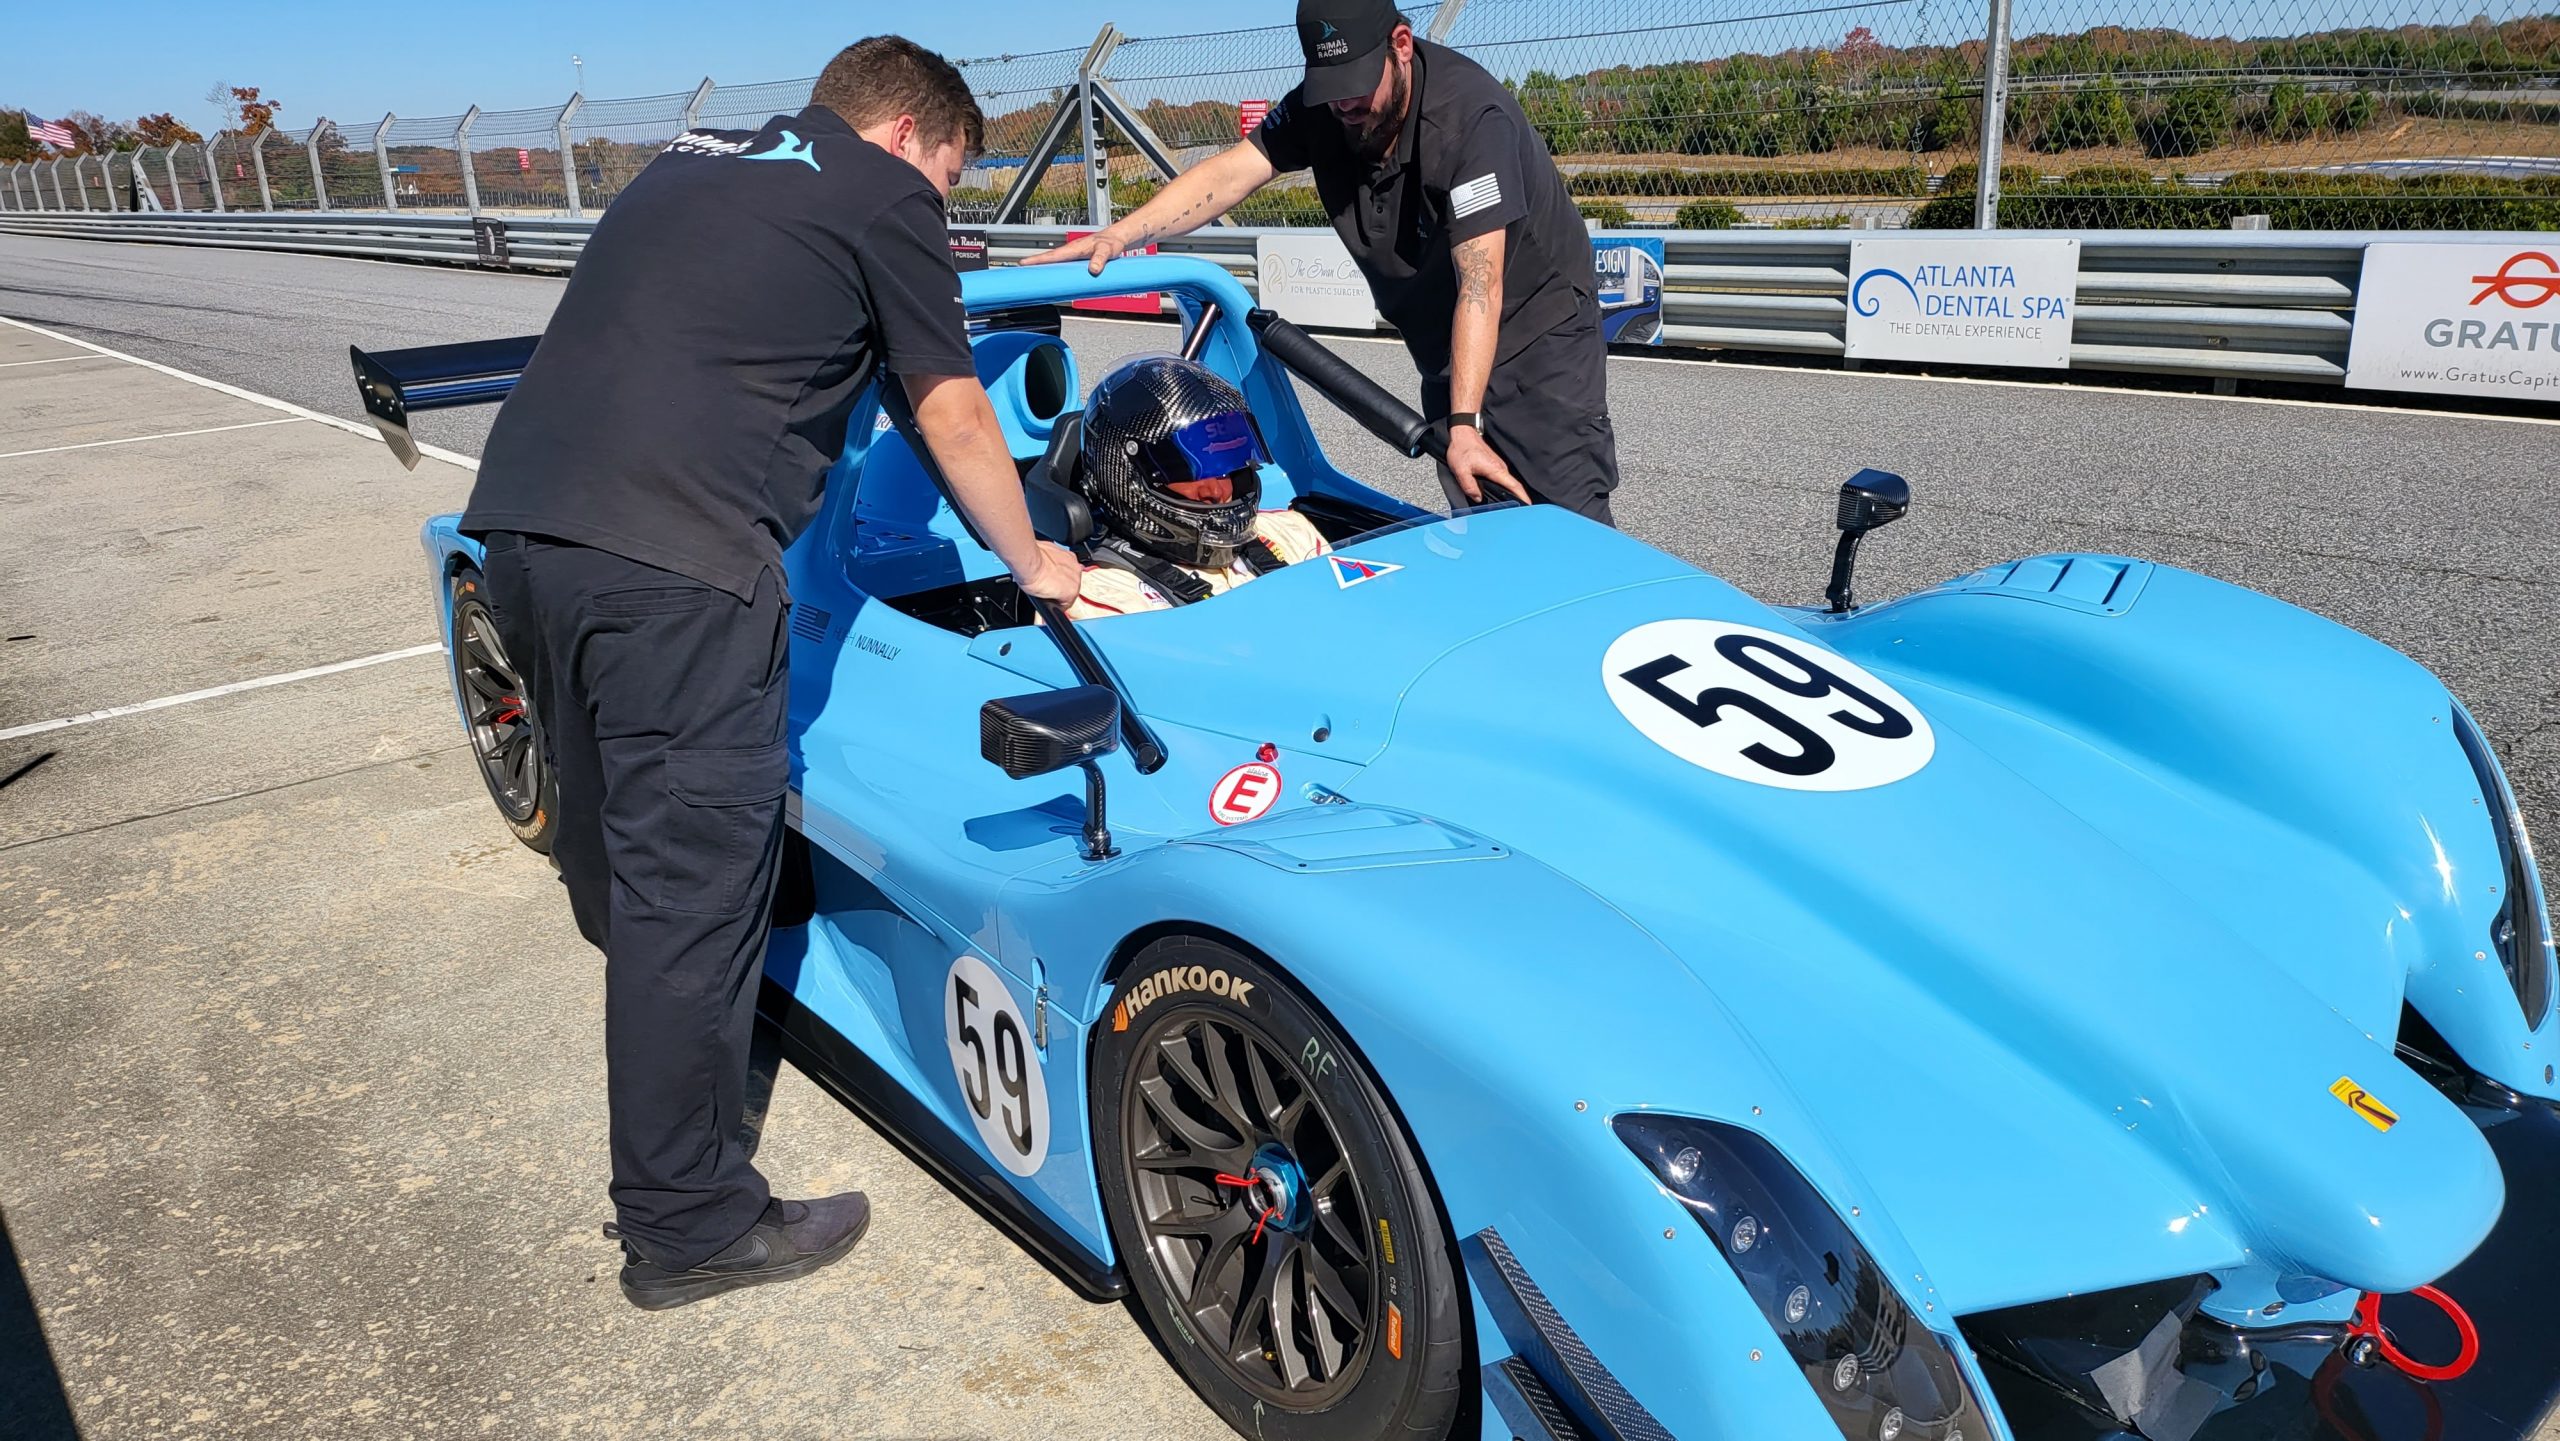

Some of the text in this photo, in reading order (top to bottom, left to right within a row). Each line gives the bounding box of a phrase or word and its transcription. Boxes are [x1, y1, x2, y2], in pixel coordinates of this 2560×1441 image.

[1316, 38, 1347, 51] PRIMAL
[1318, 45, 1349, 59] RACING
[1288, 257, 1306, 279] The
[1307, 258, 1335, 279] Swan
[1595, 249, 1626, 273] ESIGN
[1914, 265, 2015, 288] ATLANTA
[1291, 285, 1365, 297] FOR PLASTIC SURGERY
[1926, 295, 2014, 318] DENTAL
[1889, 322, 2042, 340] THE DENTAL EXPERIENCE
[855, 635, 901, 661] NUNNALLY
[1618, 634, 1913, 777] 59
[1223, 773, 1268, 814] E
[955, 974, 1032, 1156] 59
[1301, 1036, 1338, 1083] RF
